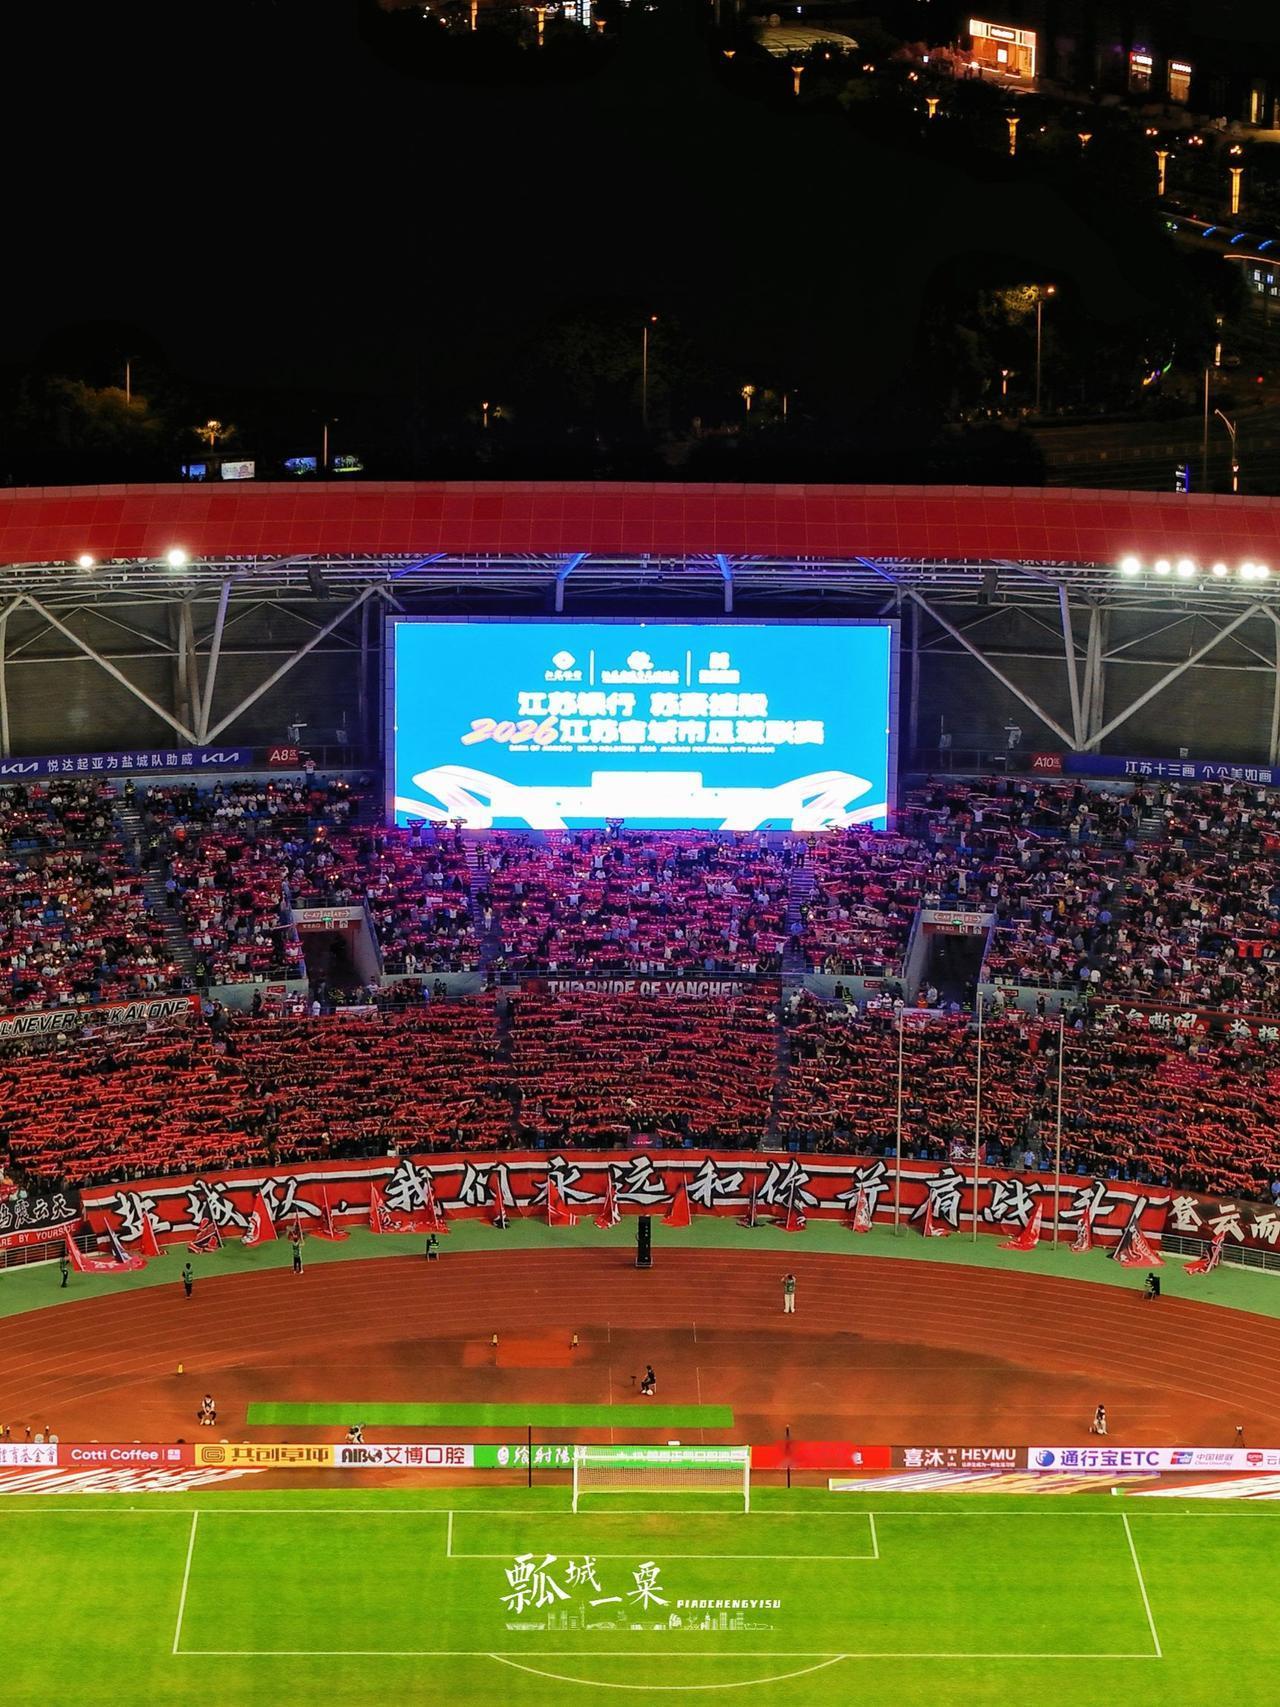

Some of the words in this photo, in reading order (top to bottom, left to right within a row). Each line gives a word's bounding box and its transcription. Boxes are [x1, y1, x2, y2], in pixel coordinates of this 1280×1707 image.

[462, 715, 558, 744] 2026
[47, 753, 194, 772] 悦达起亚为盐城队助威
[1125, 761, 1195, 778] 江苏十三画
[1202, 765, 1272, 783] 个个美如画
[640, 981, 661, 996] OF
[665, 981, 745, 996] YANCHEN
[13, 1010, 78, 1036] NEVER
[124, 998, 189, 1022] ALONE
[0, 1237, 13, 1247] RE
[18, 1233, 30, 1243] BY
[71, 1449, 107, 1460] Cotti
[110, 1449, 159, 1460] Coffee
[232, 1448, 329, 1462] 共创草坪
[384, 1447, 465, 1464] 艾博口腔
[903, 1448, 944, 1467] 喜沐
[961, 1448, 1017, 1460] HEYMU
[1060, 1450, 1159, 1467] 通行宝ETC
